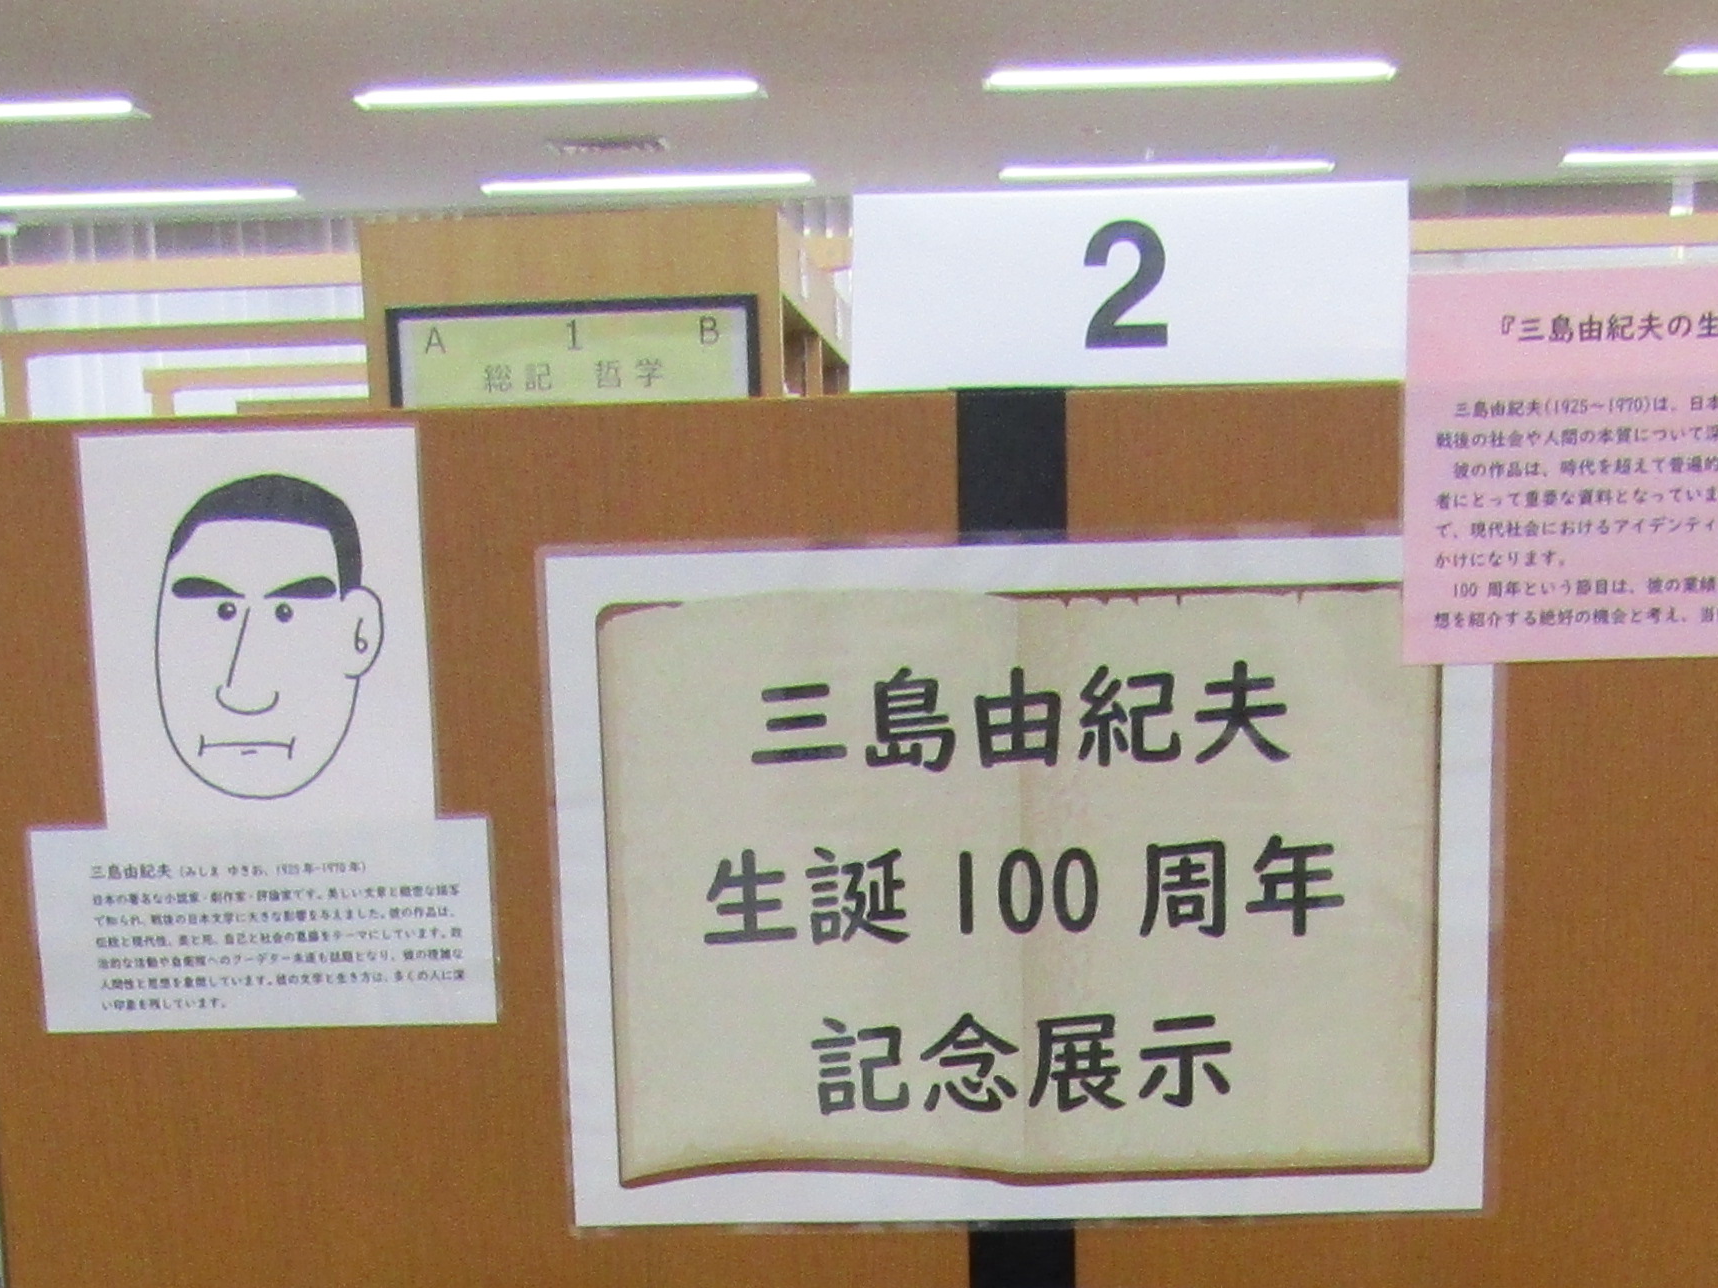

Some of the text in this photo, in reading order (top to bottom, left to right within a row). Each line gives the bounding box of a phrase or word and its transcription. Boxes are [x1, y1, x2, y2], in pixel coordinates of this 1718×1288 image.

[1084, 218, 1168, 349] 2
[426, 317, 720, 356] A 1 B
[484, 356, 664, 392] 総記 哲学
[1436, 550, 1566, 568] かけになります。
[751, 661, 1291, 771] 三島由紀夫
[90, 863, 172, 880] 三島由紀夫
[812, 1012, 1233, 1115] 記念展示
